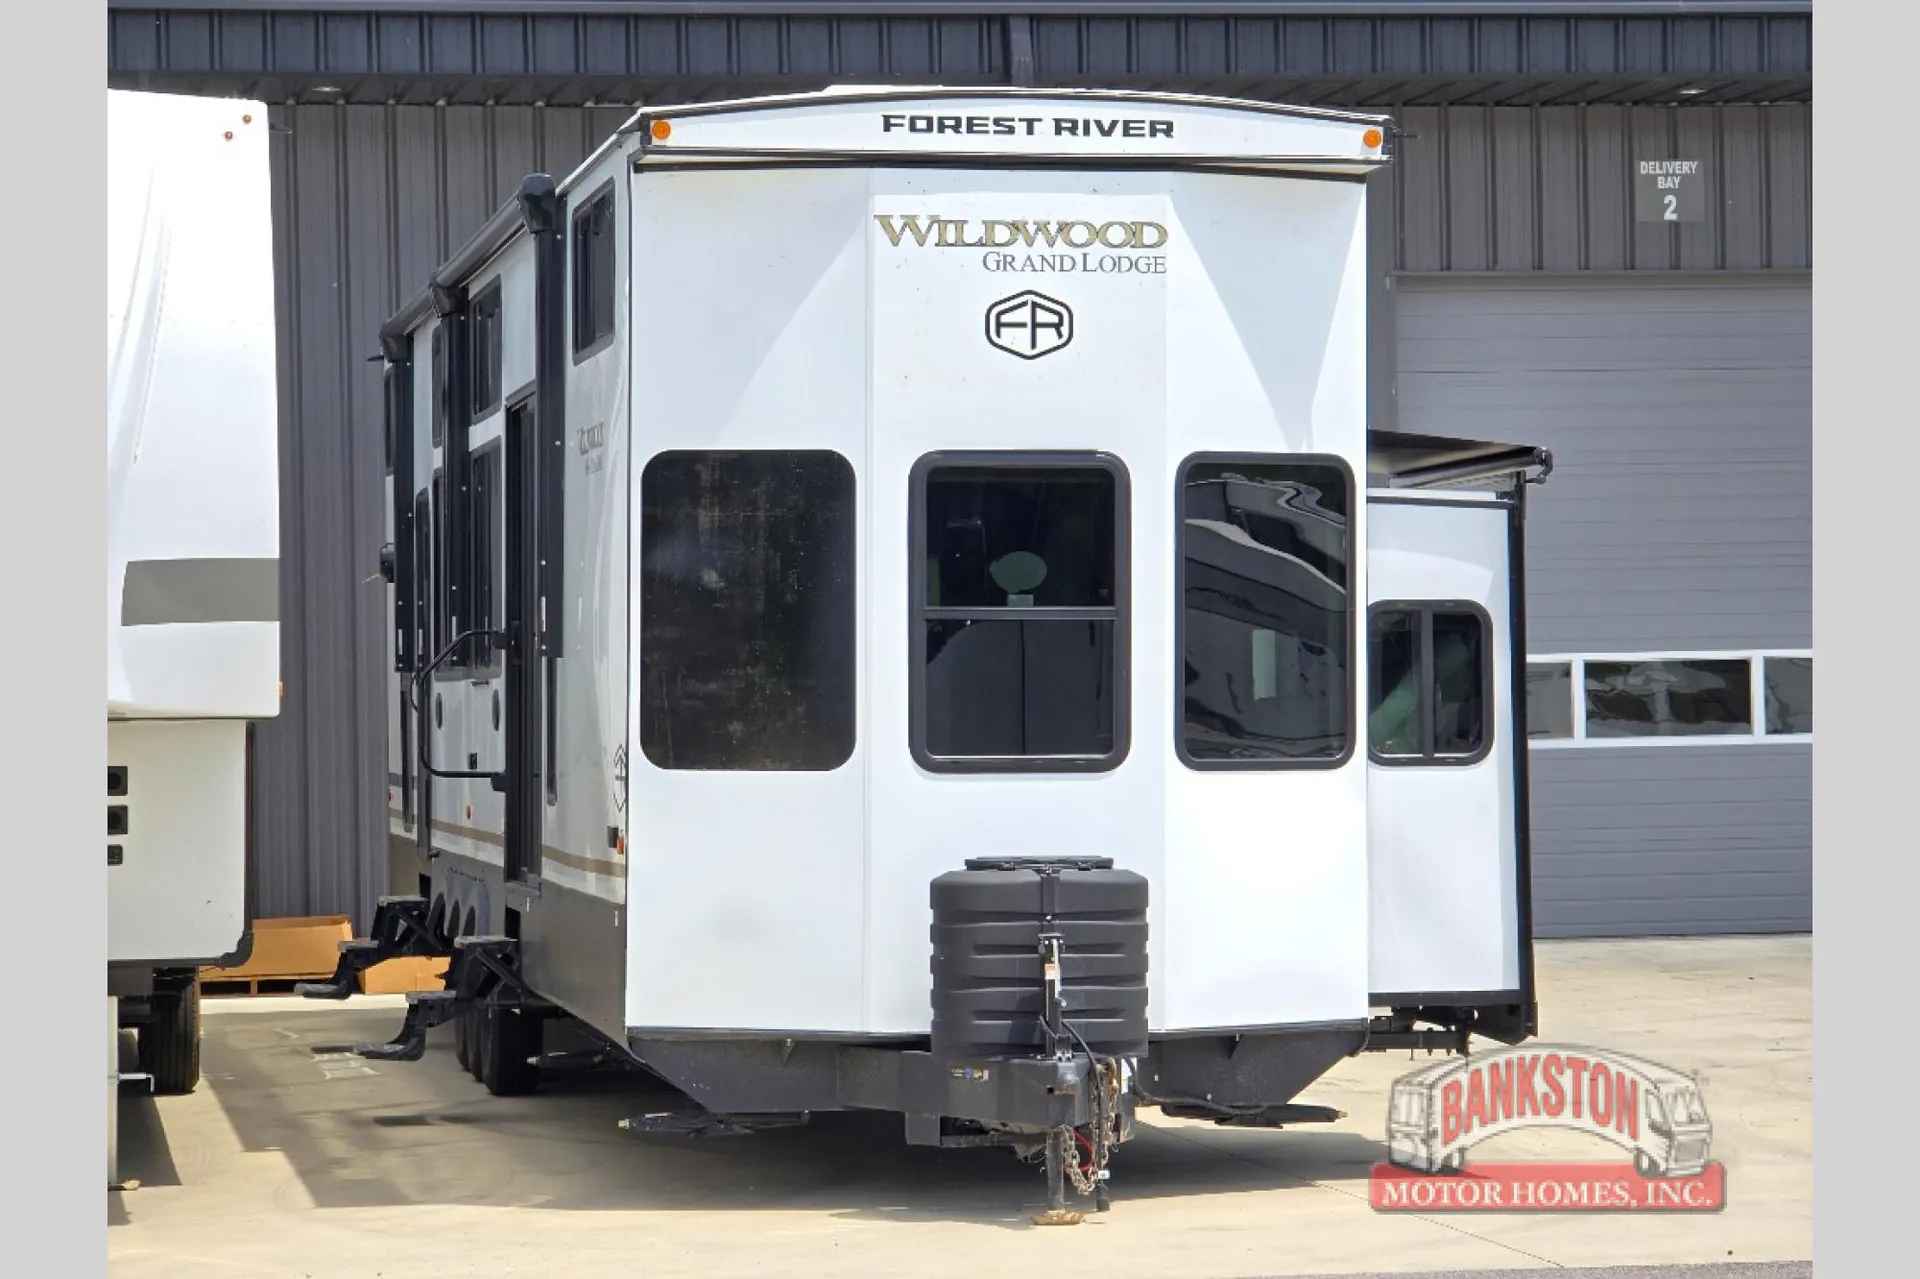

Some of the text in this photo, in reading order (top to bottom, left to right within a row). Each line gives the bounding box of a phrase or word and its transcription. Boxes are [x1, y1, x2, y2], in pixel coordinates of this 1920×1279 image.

[881, 114, 1174, 138] FOREST RIVER
[1640, 161, 1698, 174] DELIVERY
[1657, 176, 1681, 189] BAY
[1663, 194, 1678, 221] 2
[873, 214, 1169, 248] WILDWOOD
[982, 251, 1167, 274] GRAND LODGE
